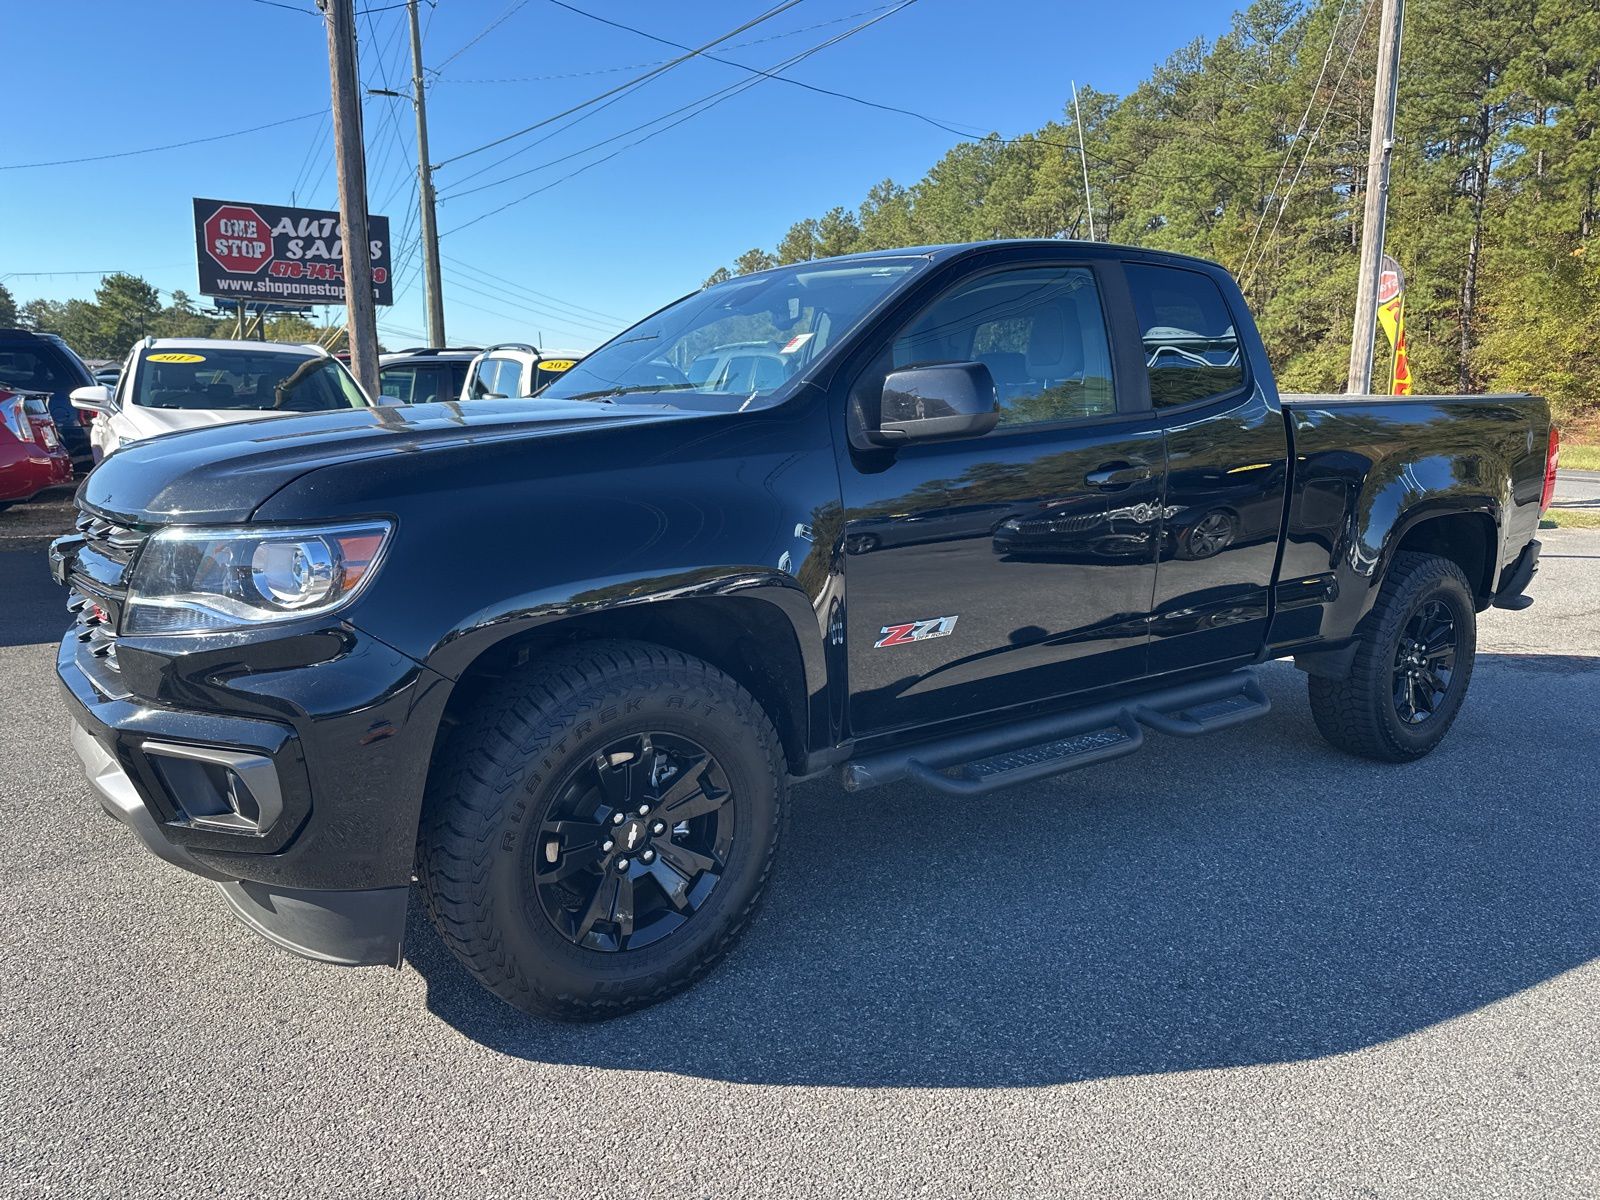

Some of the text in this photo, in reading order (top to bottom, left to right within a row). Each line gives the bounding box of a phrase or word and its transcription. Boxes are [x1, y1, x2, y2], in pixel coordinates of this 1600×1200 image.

[220, 218, 258, 239] ONE
[214, 238, 267, 259] STOP
[285, 239, 383, 260] SALS
[547, 361, 570, 369] 202
[873, 615, 959, 649] Z71
[665, 694, 721, 717] A/T
